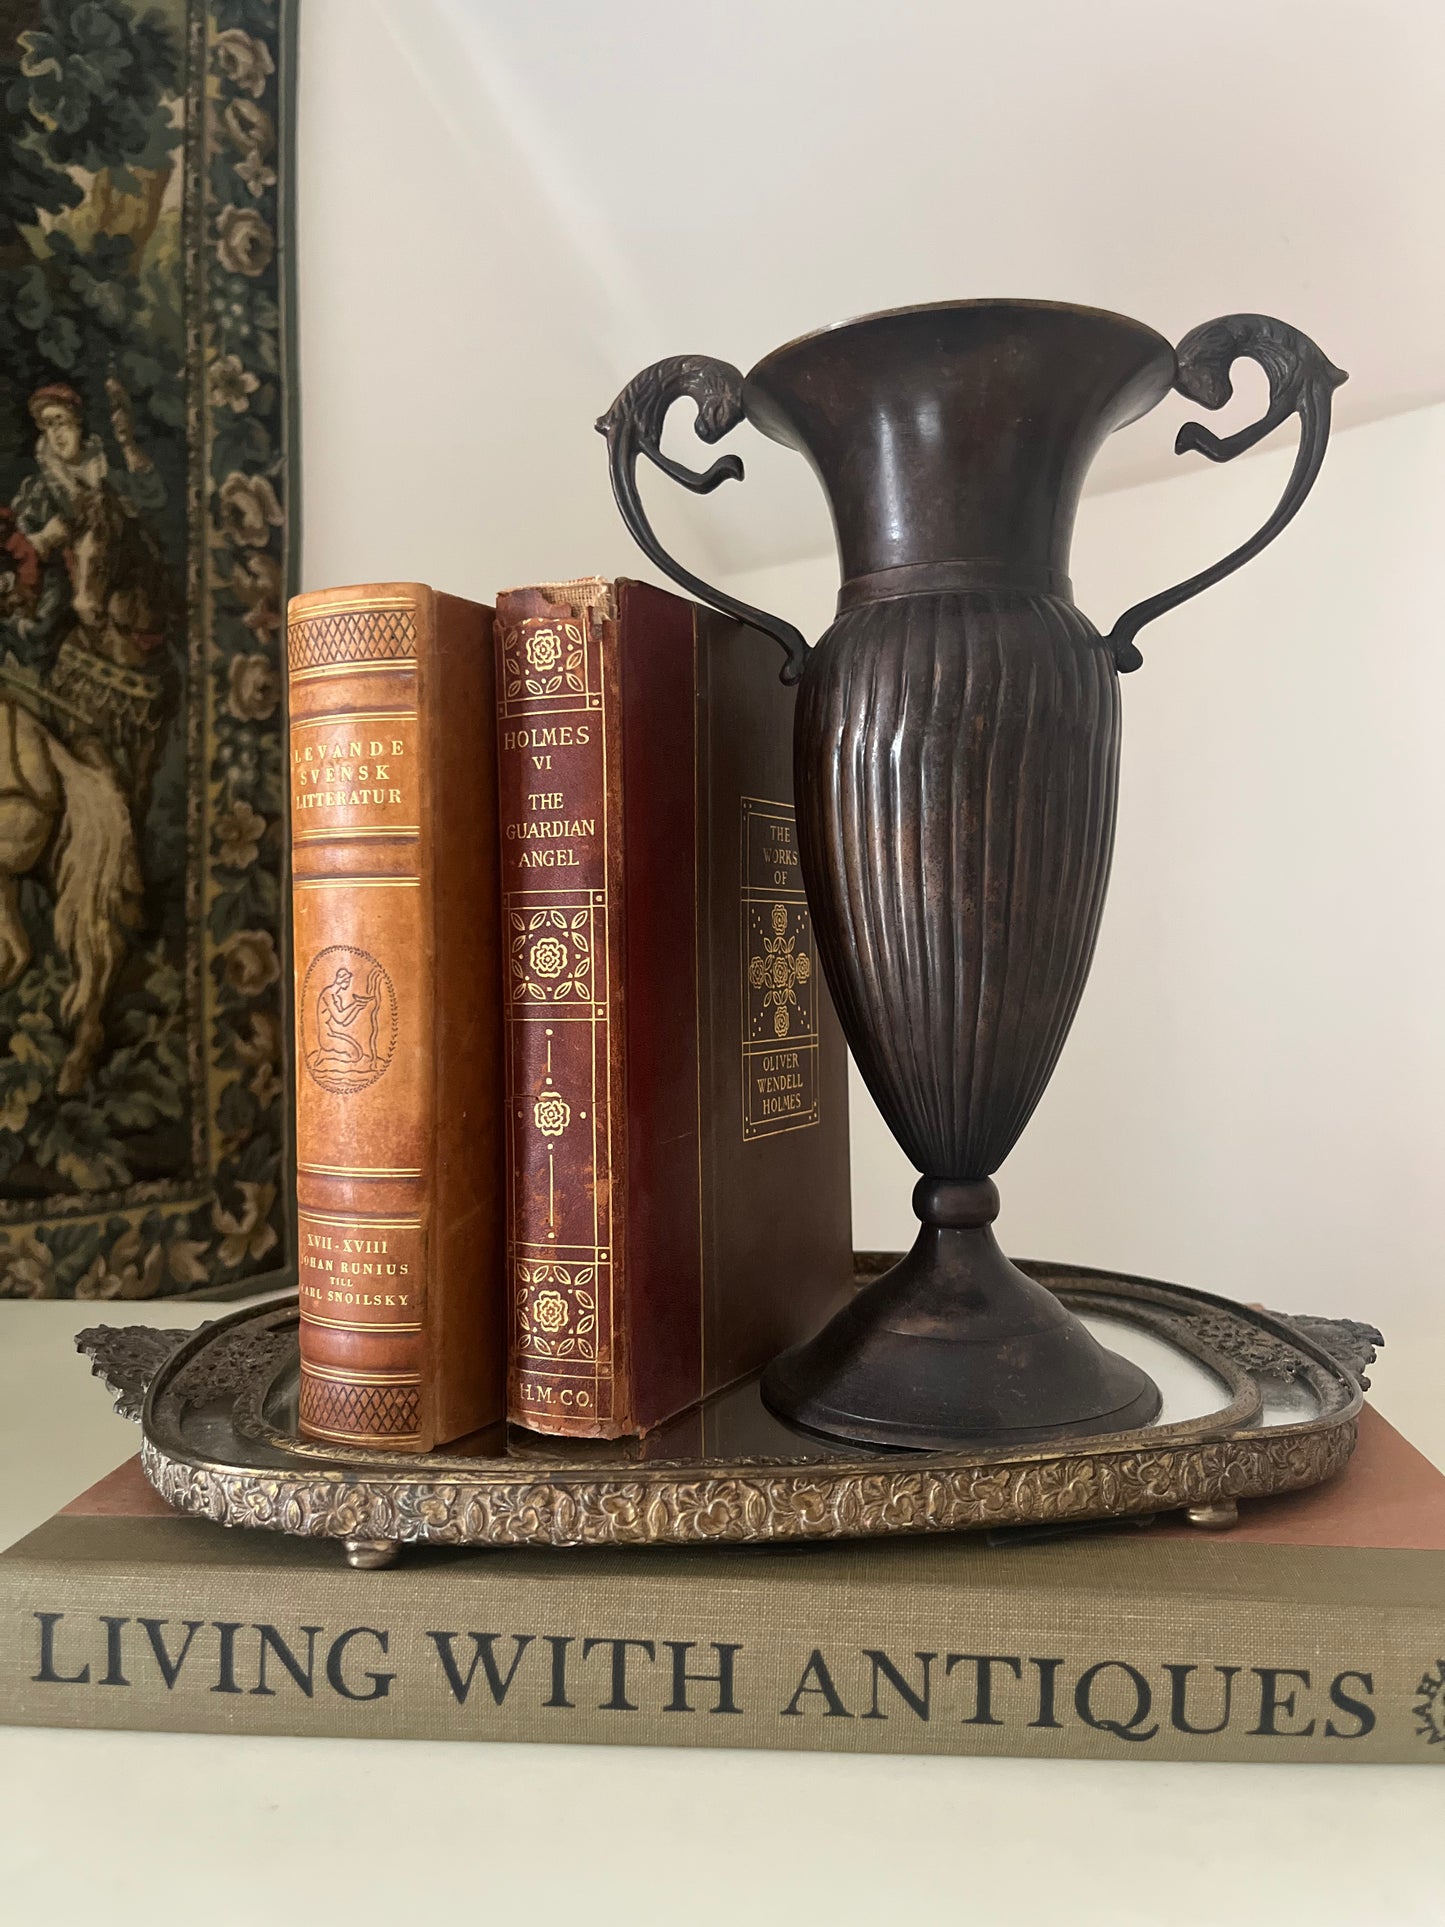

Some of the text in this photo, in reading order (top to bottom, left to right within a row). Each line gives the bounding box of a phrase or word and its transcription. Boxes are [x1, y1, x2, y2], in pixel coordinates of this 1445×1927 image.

[504, 726, 590, 750] HOLMES
[295, 741, 404, 763] LEVANDE
[532, 756, 552, 770] VI
[300, 765, 390, 785] SVENSK
[296, 789, 402, 810] LITTERATUR
[528, 792, 564, 811] THE
[506, 819, 596, 840] GUARDIAN
[770, 825, 791, 843] THE
[518, 849, 580, 868] ANGEL
[763, 847, 799, 866] WORKS
[773, 870, 788, 885] OF
[763, 1053, 799, 1072] OLIVER
[757, 1073, 804, 1094] WENDELL
[762, 1093, 802, 1115] HOLMES
[341, 1262, 409, 1275] RUNIUS
[329, 1276, 354, 1287] TILL
[327, 1290, 409, 1306] SNOILSKY
[31, 1612, 1377, 1742] LIVING WITH ANTIQUES
